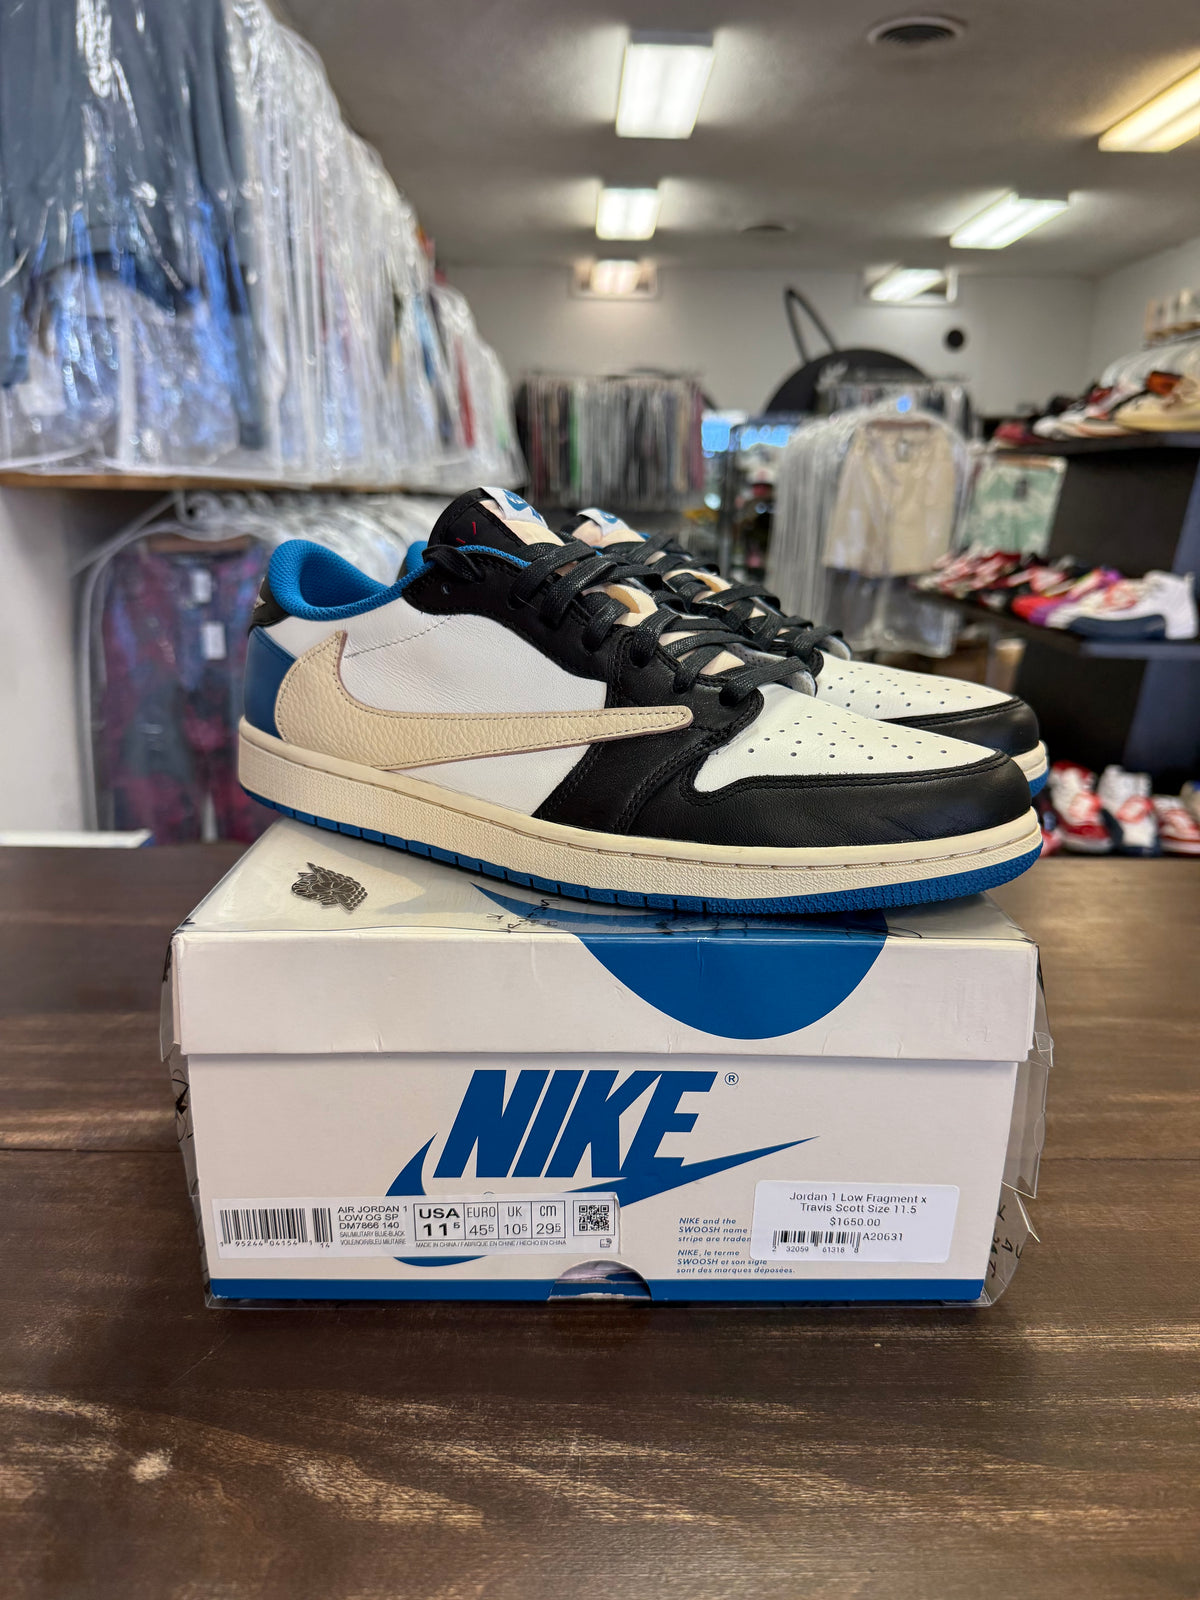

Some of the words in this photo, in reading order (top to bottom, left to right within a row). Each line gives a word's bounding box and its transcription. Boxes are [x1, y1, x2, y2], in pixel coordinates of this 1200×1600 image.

[433, 1069, 719, 1179] NIKE
[789, 1192, 828, 1201] Jordan
[831, 1192, 836, 1201] 1
[840, 1193, 864, 1202] Low
[866, 1194, 918, 1204] Fragment
[358, 1205, 400, 1213] JORDAN
[466, 1206, 496, 1218] EURO
[507, 1205, 523, 1217] UK
[800, 1202, 832, 1212] Travis
[835, 1203, 864, 1213] Scott
[867, 1204, 890, 1214] Size
[894, 1205, 917, 1214] 11.5
[365, 1213, 382, 1221] OG
[419, 1207, 461, 1219] USA
[339, 1222, 379, 1230] DM7866
[382, 1221, 400, 1229] 140
[679, 1217, 700, 1225] NIKE
[829, 1217, 881, 1227] $1650.00
[862, 1232, 903, 1241] A20631
[677, 1249, 701, 1257] NIKE,
[714, 1267, 752, 1275] marques
